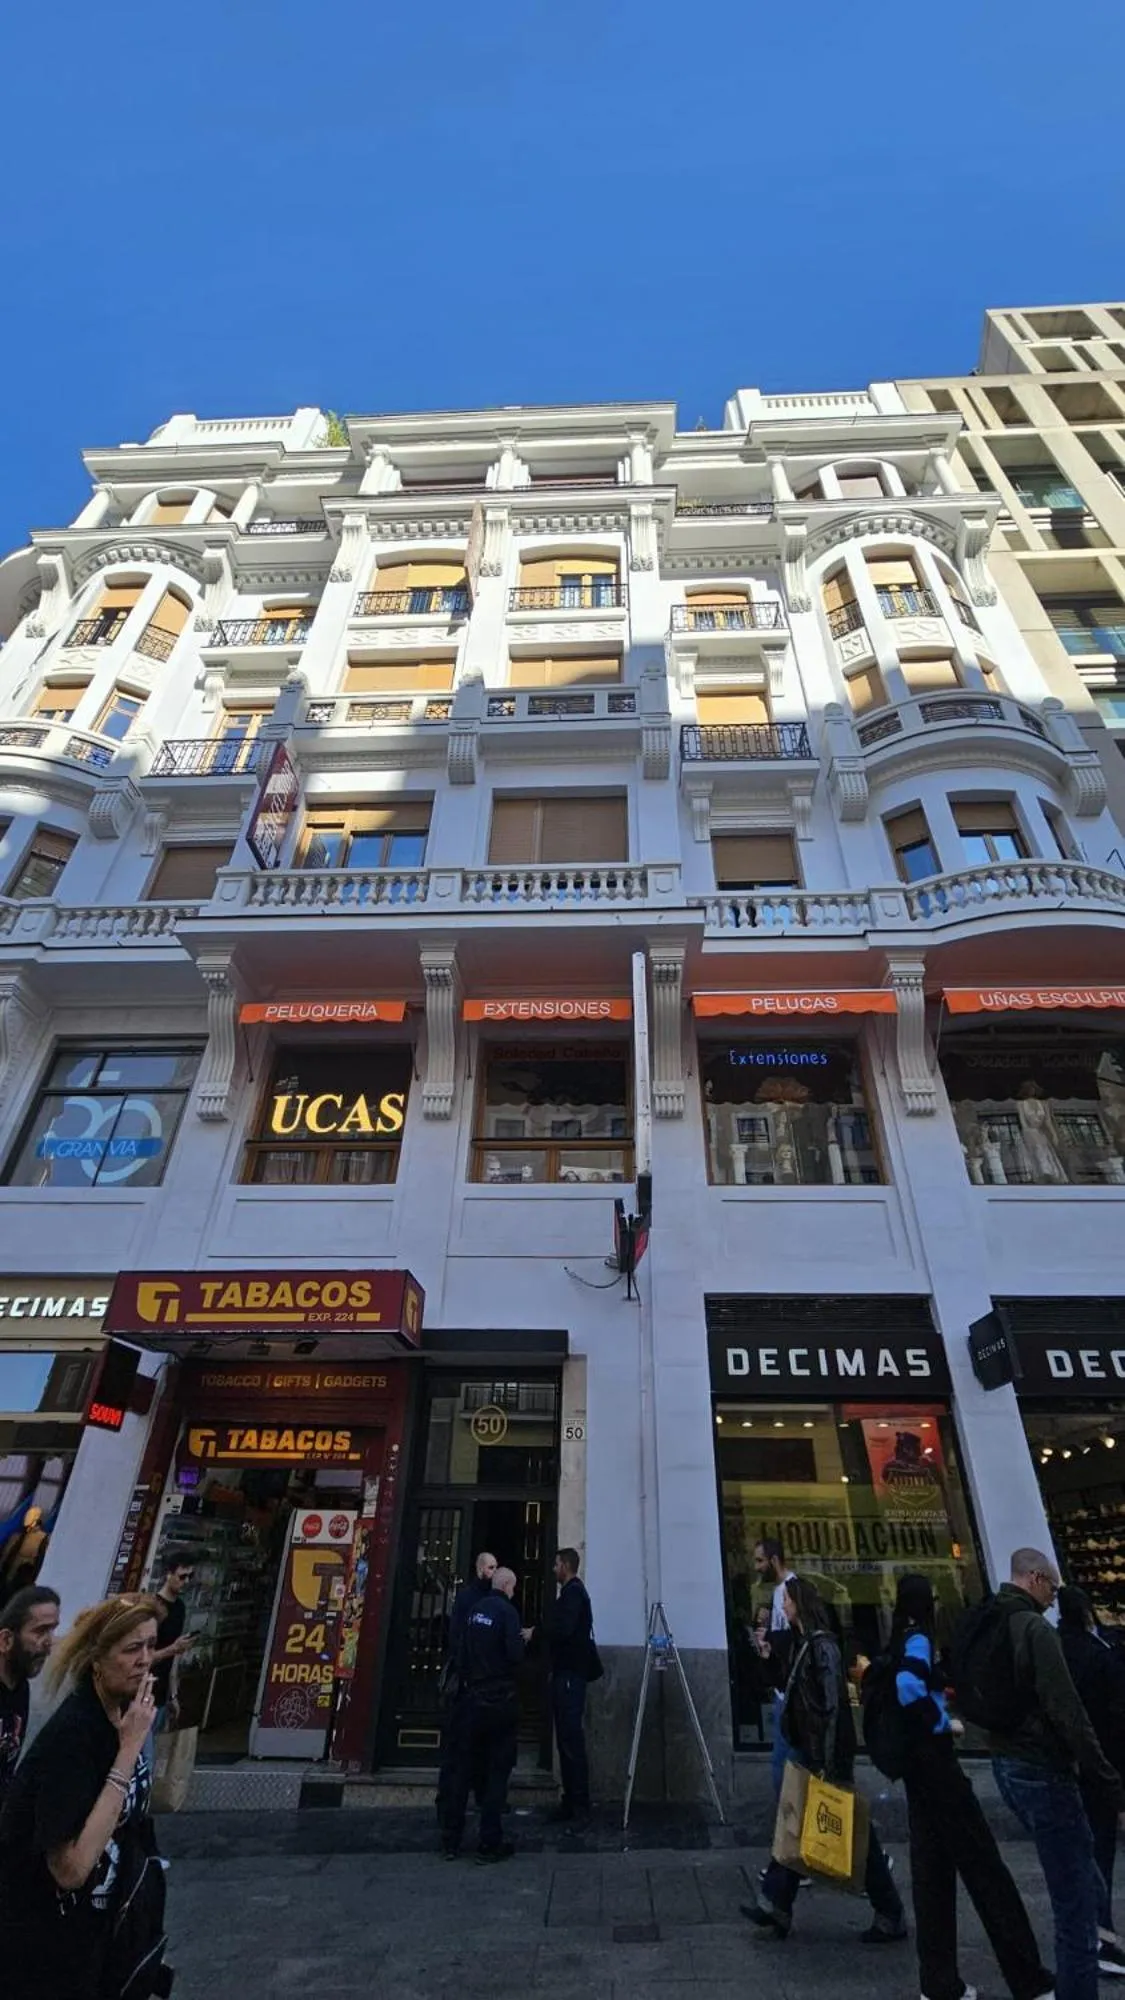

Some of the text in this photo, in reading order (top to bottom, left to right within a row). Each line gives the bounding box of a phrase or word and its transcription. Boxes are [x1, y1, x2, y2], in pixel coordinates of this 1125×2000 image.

[751, 997, 838, 1010] PELUCAS
[979, 991, 1034, 1006] UÑAS
[265, 1002, 378, 1018] PELUQUERÍA
[484, 1002, 611, 1016] EXTENSIONES
[729, 1049, 828, 1065] Extensiones
[271, 1093, 405, 1135] UCAS
[200, 1281, 372, 1309] TABACOS
[726, 1347, 931, 1377] DECIMAS
[201, 1374, 388, 1388] TOBACCO GIFTS GADGETS
[476, 1416, 501, 1434] 50
[566, 1427, 583, 1440] 50
[227, 1428, 352, 1451] TABACOS
[285, 1623, 326, 1654] 24
[271, 1663, 334, 1683] HORAS
